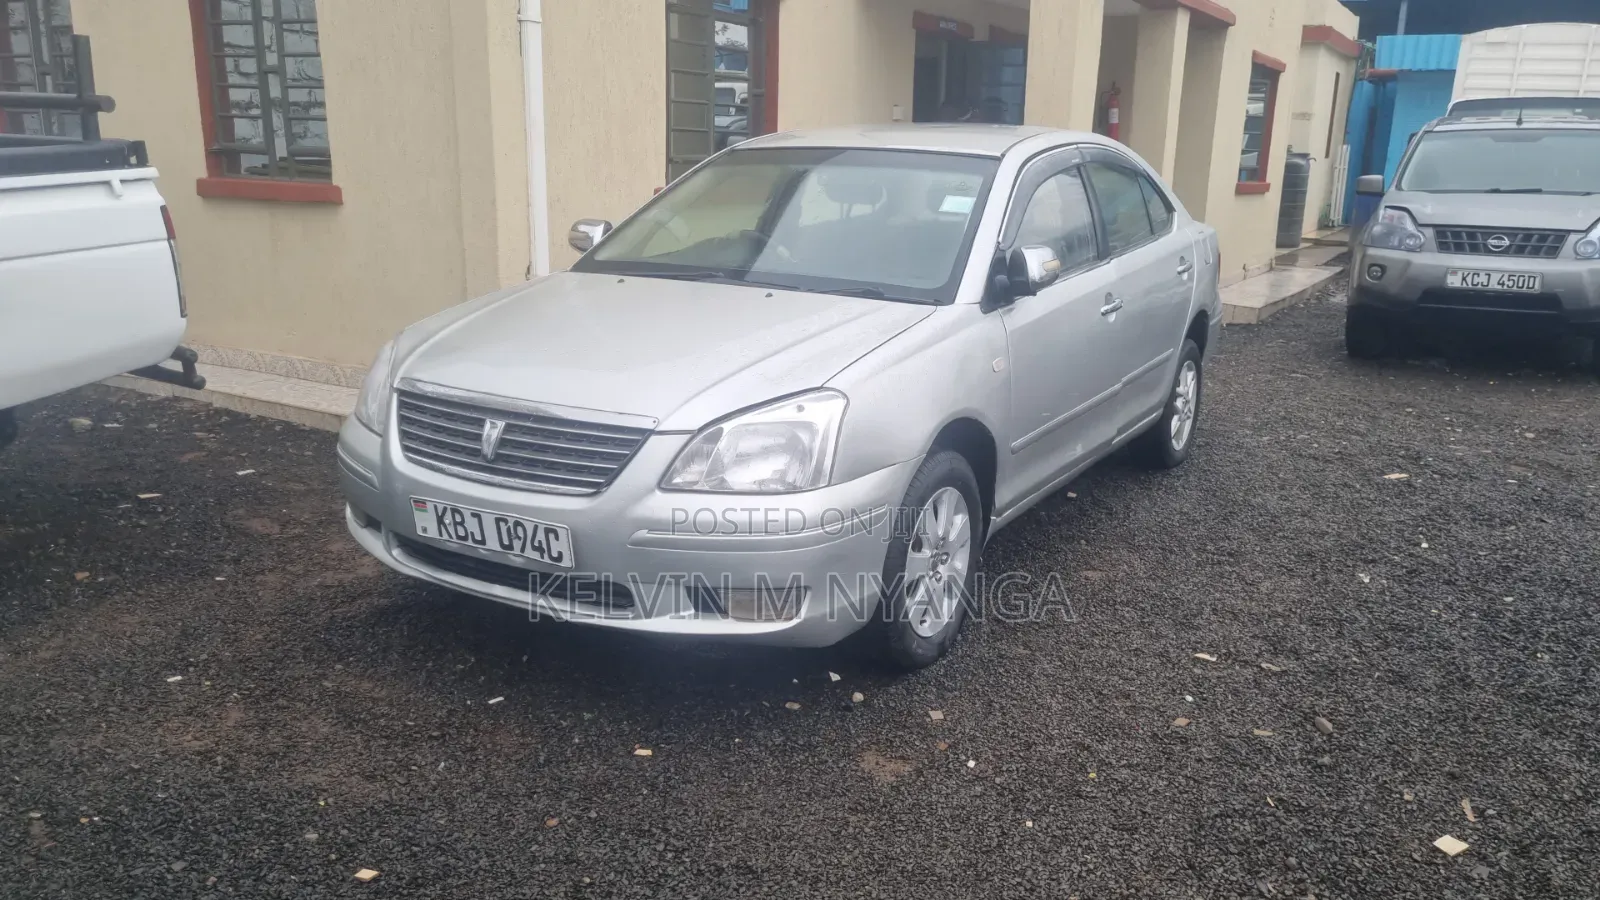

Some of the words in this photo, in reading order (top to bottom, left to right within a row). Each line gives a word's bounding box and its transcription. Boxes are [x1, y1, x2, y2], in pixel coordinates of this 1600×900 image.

[1460, 272, 1492, 288] KCJ
[1496, 273, 1537, 290] 450D
[433, 503, 487, 547] KBJ
[494, 516, 564, 564] 094C
